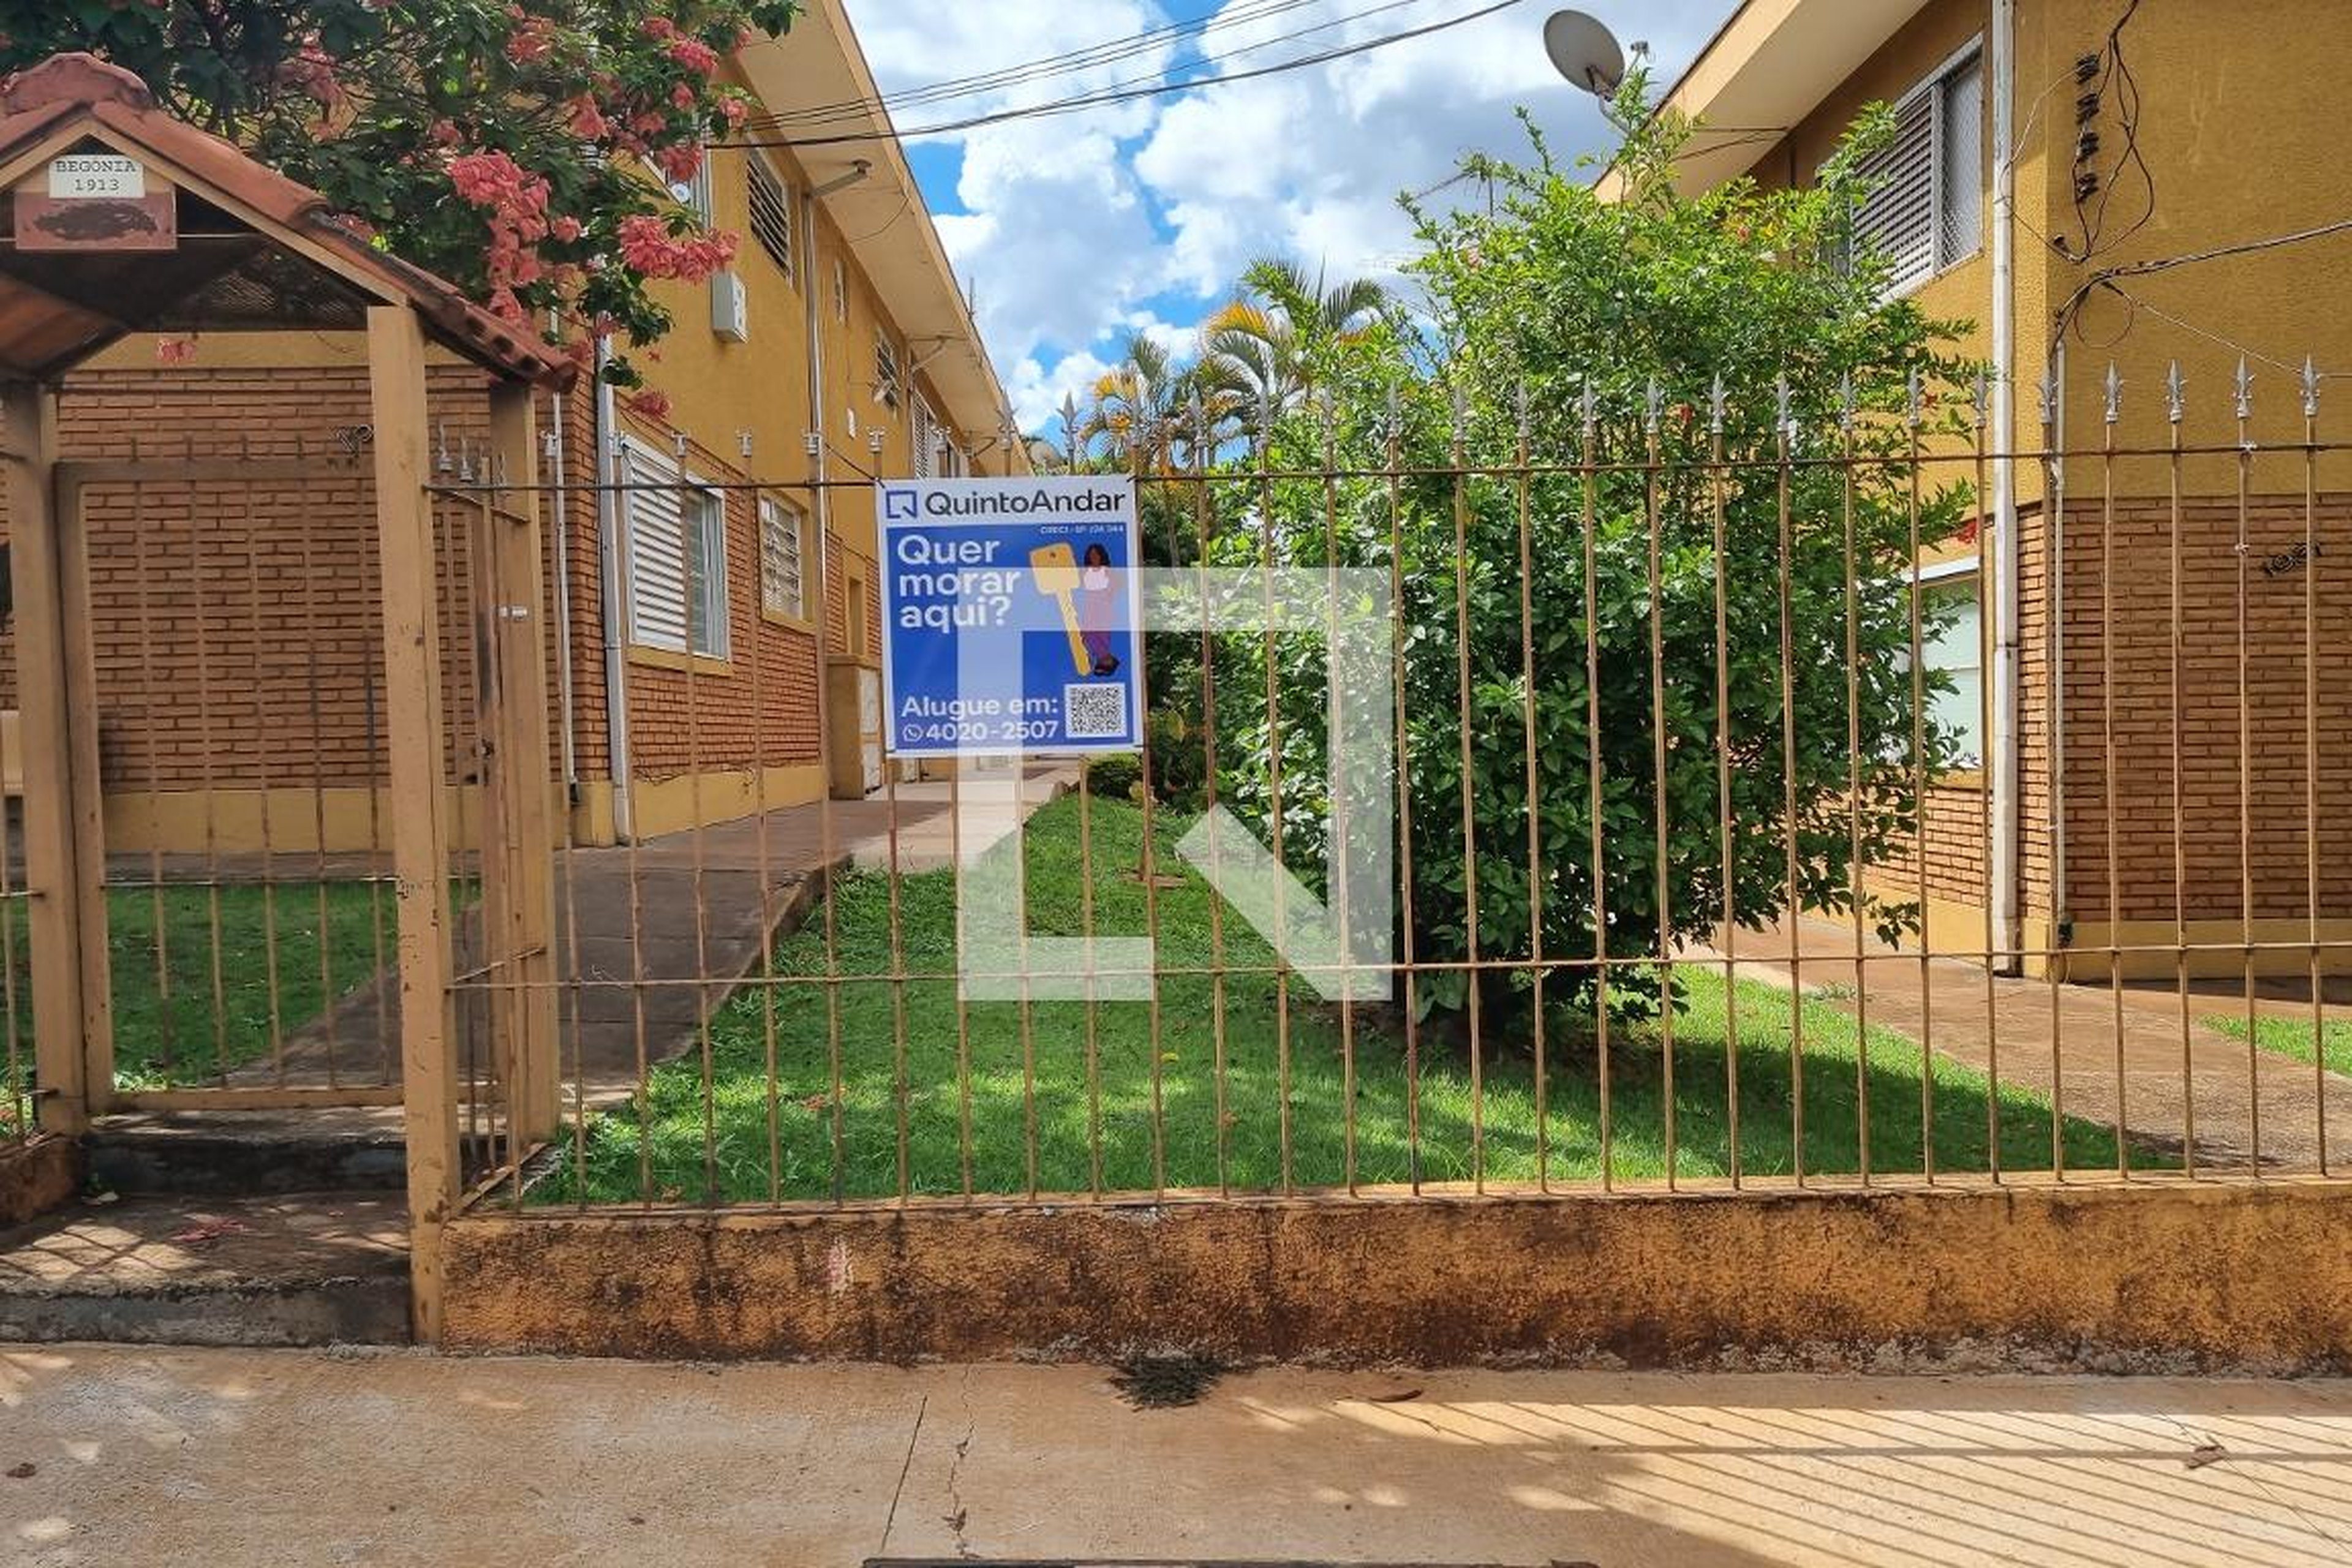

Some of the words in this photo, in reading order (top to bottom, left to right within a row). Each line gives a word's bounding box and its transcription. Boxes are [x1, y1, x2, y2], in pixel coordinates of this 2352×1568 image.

[75, 179, 120, 190] 1913
[925, 489, 1125, 516] QuintoAndar
[897, 534, 1001, 565] Quer
[899, 571, 1020, 597] morar
[900, 597, 1011, 633] aqui?
[902, 696, 1000, 721] Alugue
[1009, 697, 1058, 714] em:
[925, 720, 1058, 741] 4020-2507
